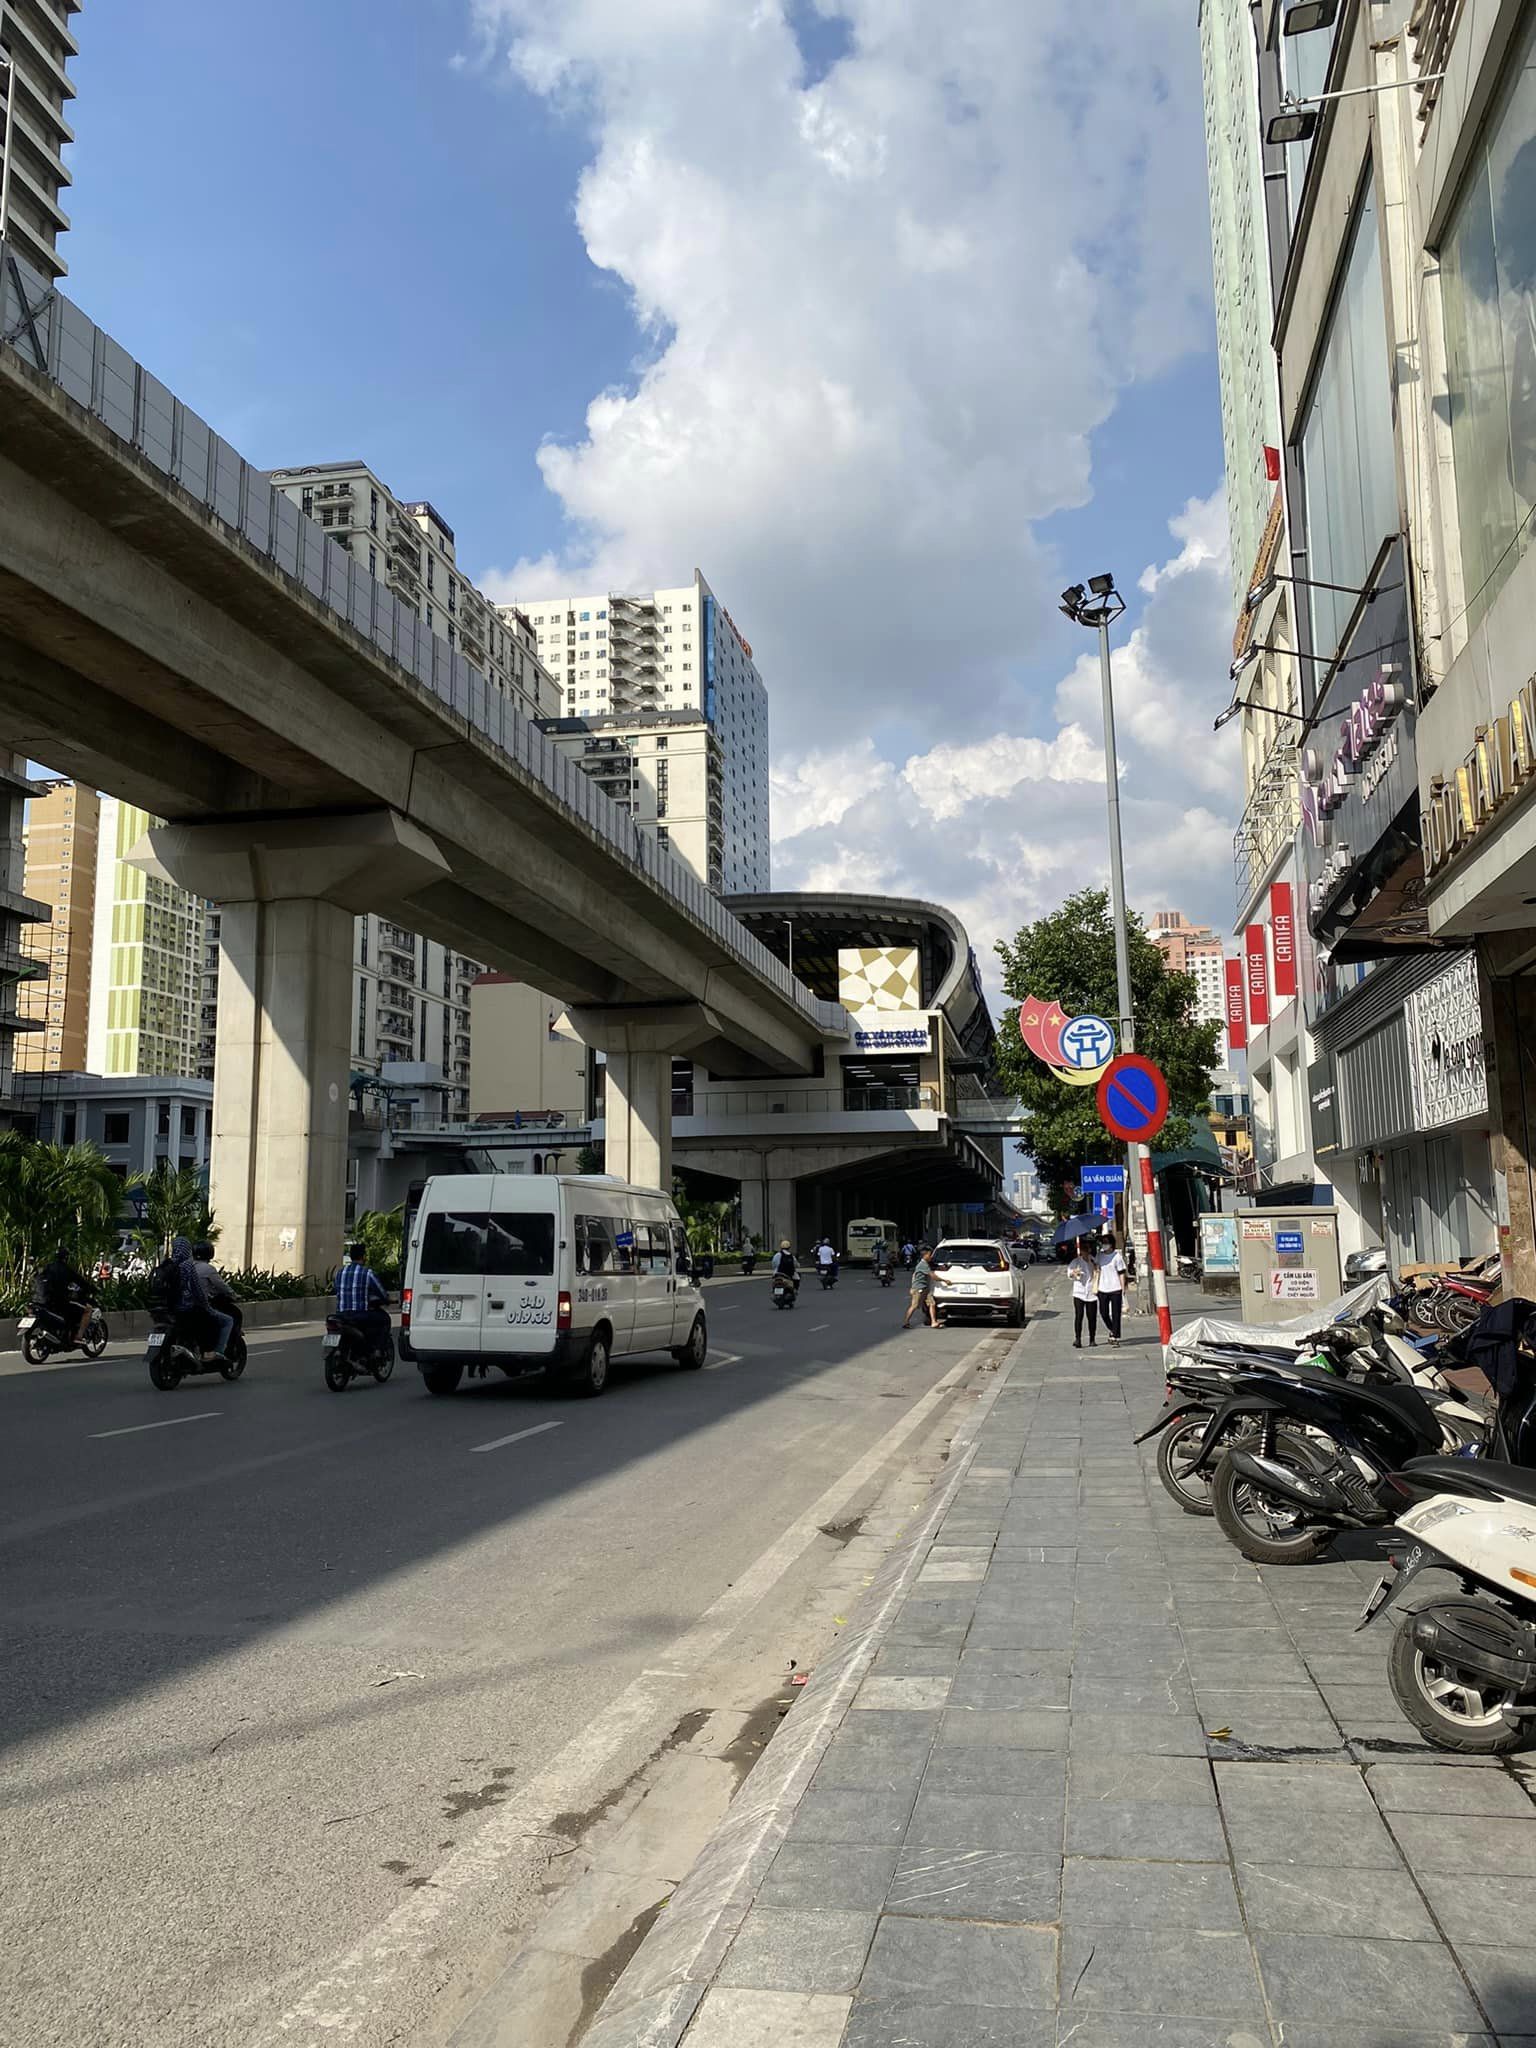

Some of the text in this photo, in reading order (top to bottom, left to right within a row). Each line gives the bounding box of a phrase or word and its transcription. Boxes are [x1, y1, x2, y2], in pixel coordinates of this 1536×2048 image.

[1275, 915, 1292, 963] CANIFA
[1250, 953, 1265, 995] CANIFA
[1229, 985, 1243, 1023] CANIFA
[1083, 1175, 1093, 1183] GA
[520, 1295, 545, 1309] 34D
